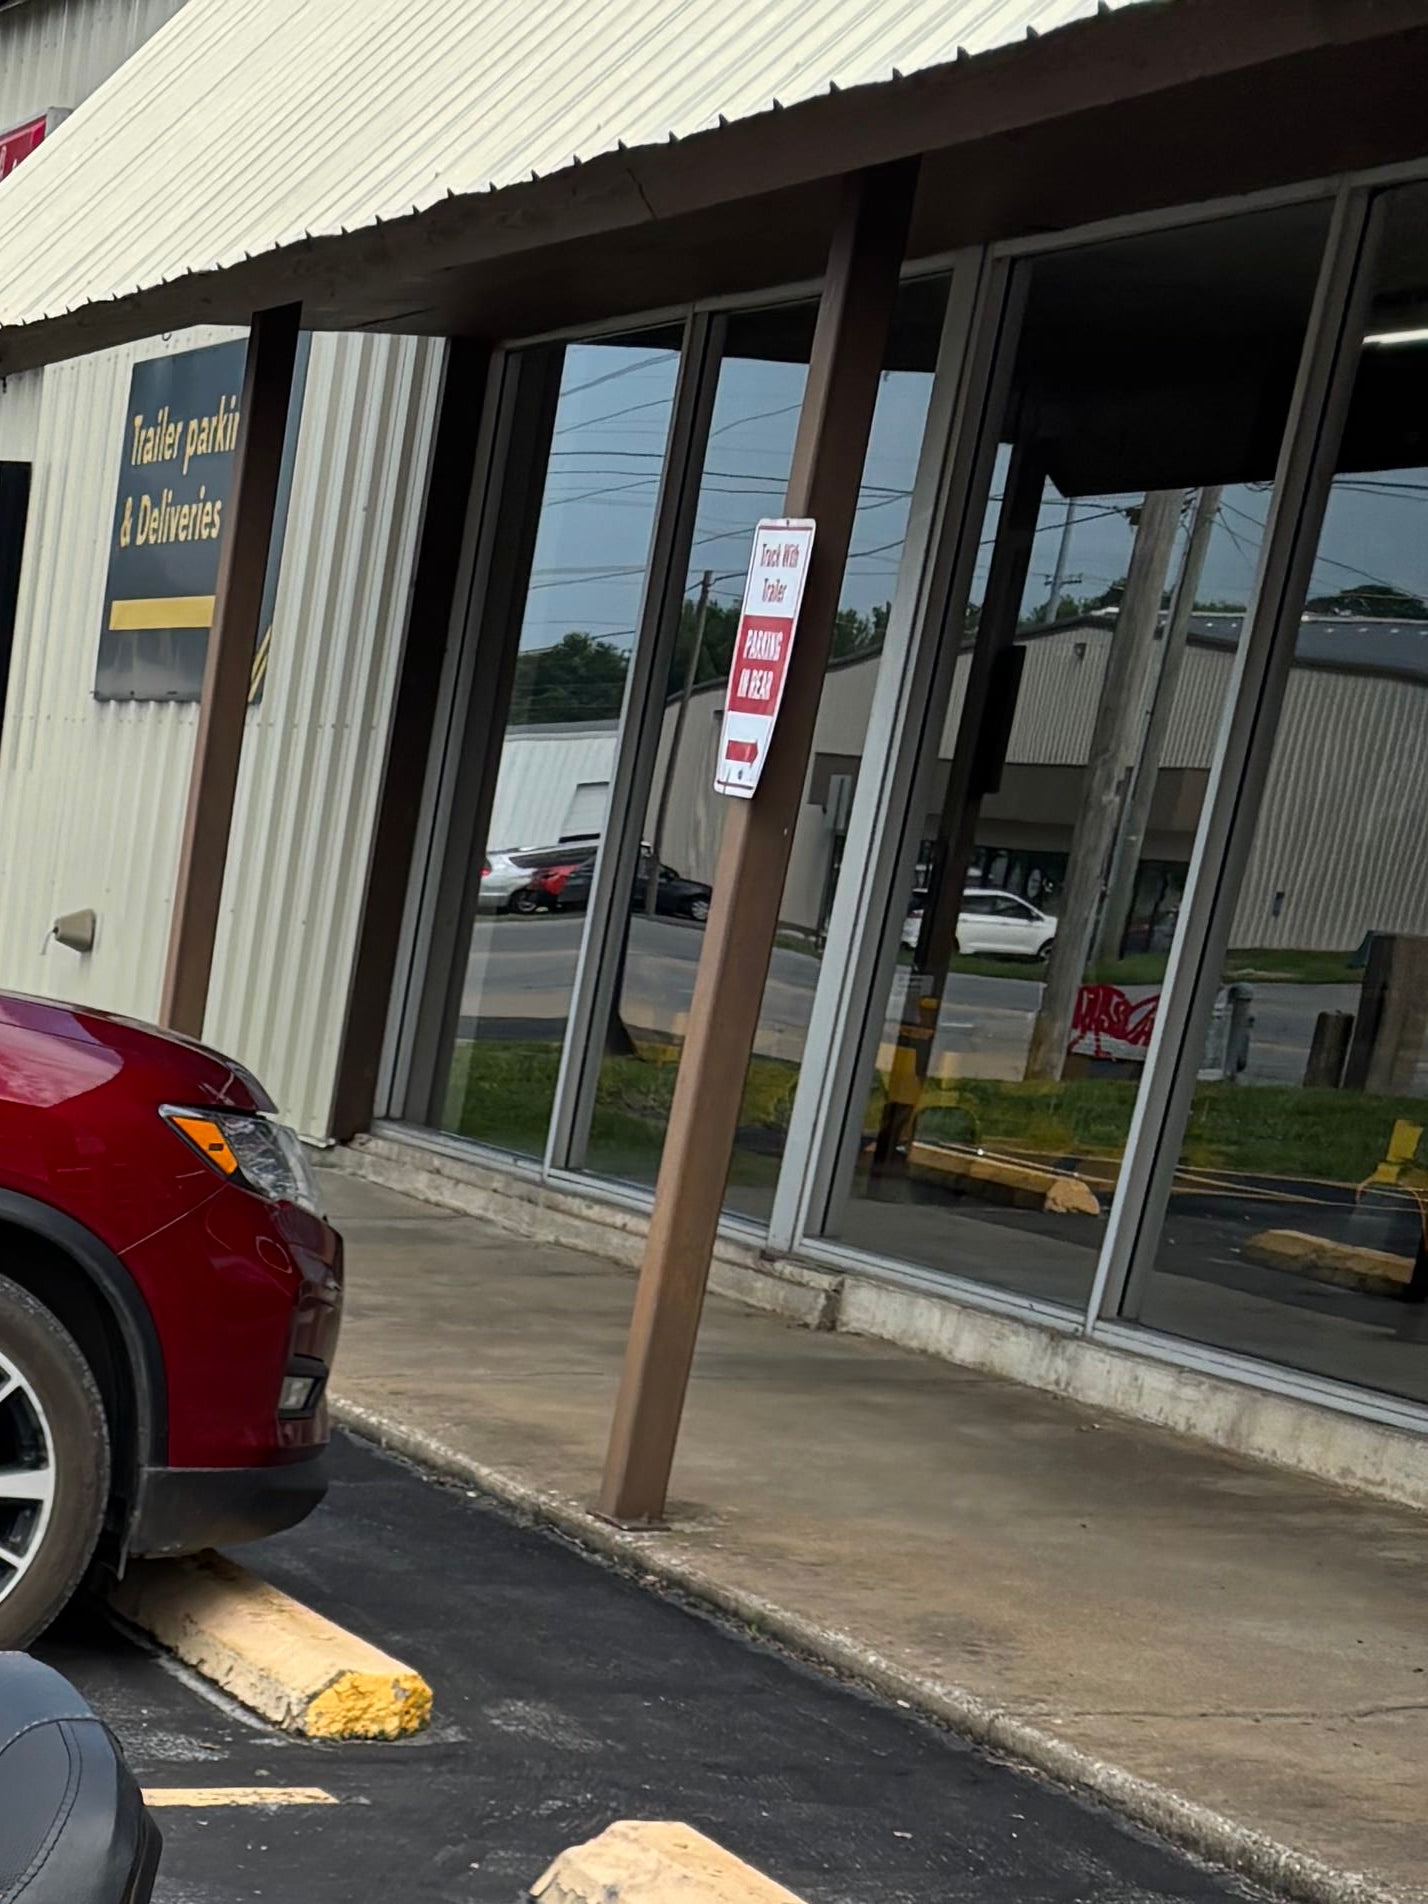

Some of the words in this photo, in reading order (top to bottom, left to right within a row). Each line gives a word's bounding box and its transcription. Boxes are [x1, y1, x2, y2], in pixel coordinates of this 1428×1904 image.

[130, 405, 183, 467] Trailer
[119, 495, 133, 549] &
[135, 485, 223, 547] Deliveries
[742, 629, 784, 662] PARKING
